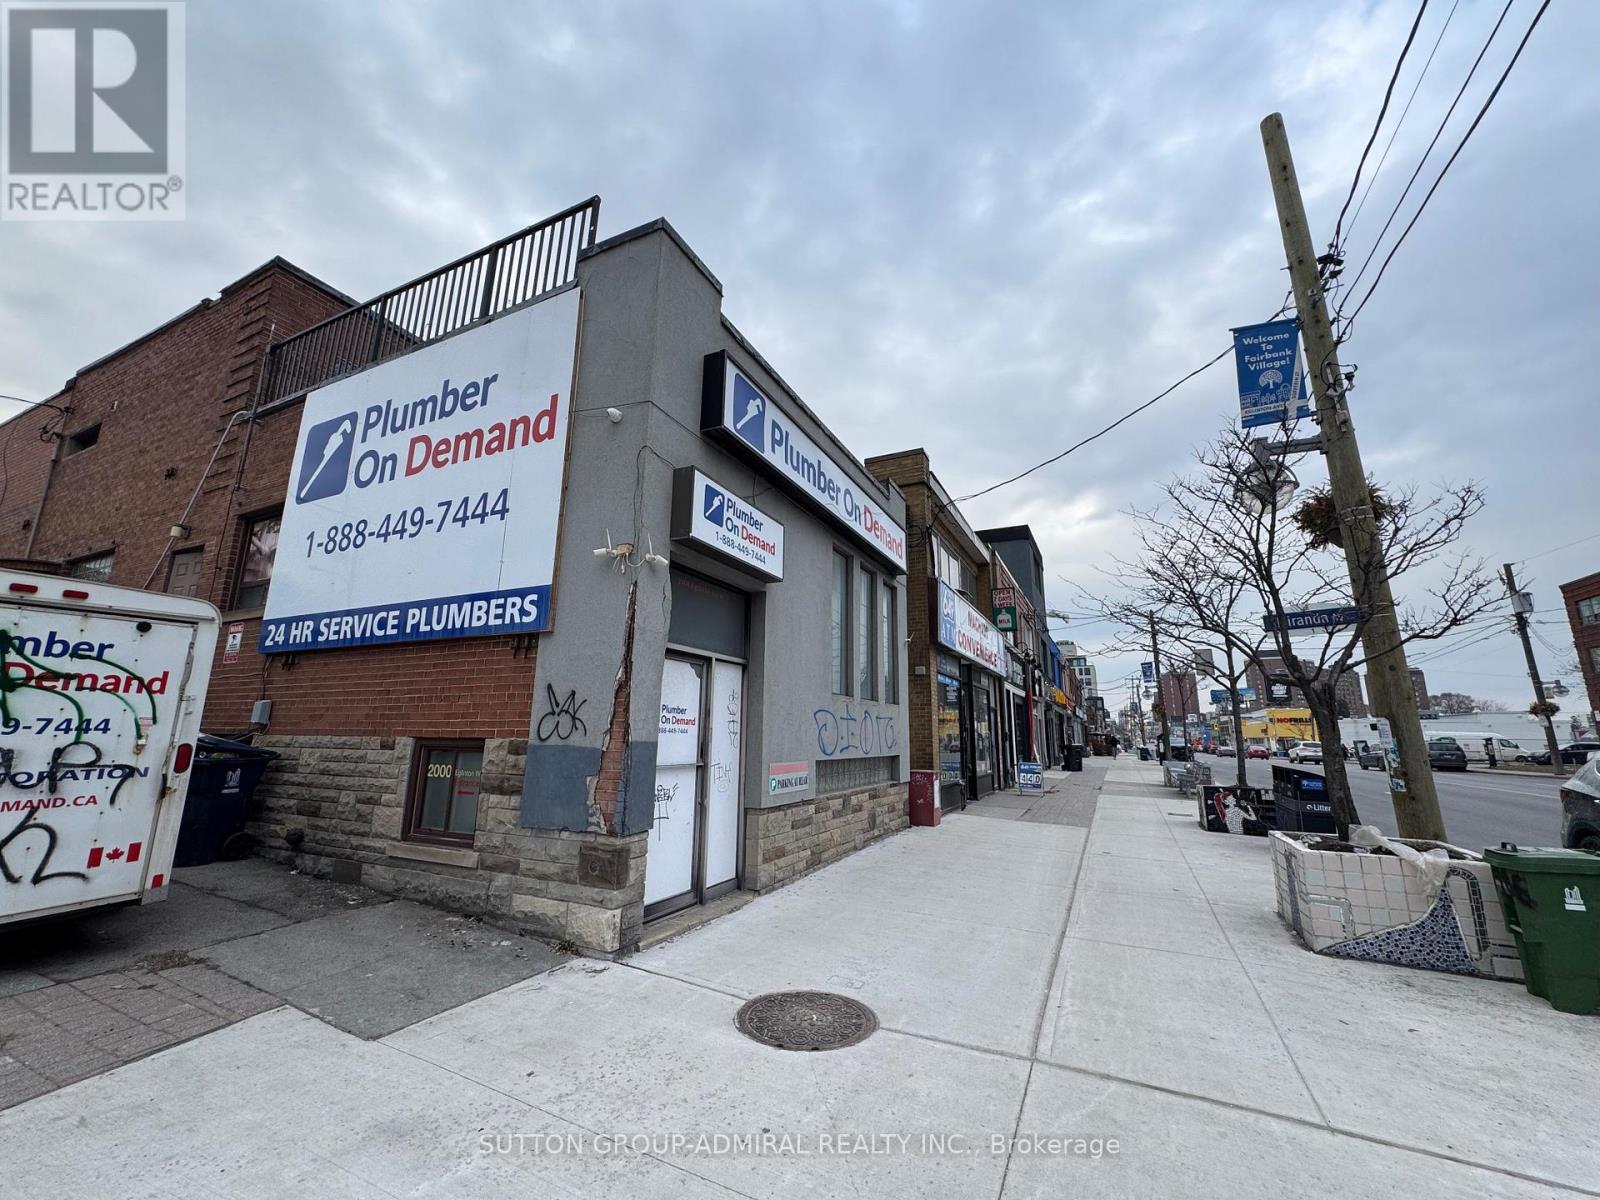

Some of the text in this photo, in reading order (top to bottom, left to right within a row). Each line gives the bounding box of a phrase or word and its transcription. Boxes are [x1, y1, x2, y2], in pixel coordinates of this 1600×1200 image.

[1242, 333, 1290, 345] Welcome
[1261, 343, 1273, 351] To
[1244, 348, 1293, 364] Fairbank
[1248, 358, 1290, 371] Village!
[361, 373, 499, 443] Plumber
[354, 393, 560, 489] On Demand
[770, 418, 903, 561] Plumber On Demand
[306, 488, 510, 558] 1-888-449-7444
[726, 497, 764, 533] Plumber
[715, 531, 766, 565] 1-888-449-7444
[725, 517, 776, 557] On Demand
[264, 593, 539, 647] 24 HR SERVICE PLUMBERS
[1274, 612, 1329, 630] iranda
[0, 631, 114, 661] mber
[3, 661, 169, 694] Demand
[661, 714, 696, 726] On Demand
[662, 704, 687, 715] Plumber
[0, 766, 149, 786] ORATION
[427, 764, 452, 778] 2000
[1313, 803, 1331, 812] Litter
